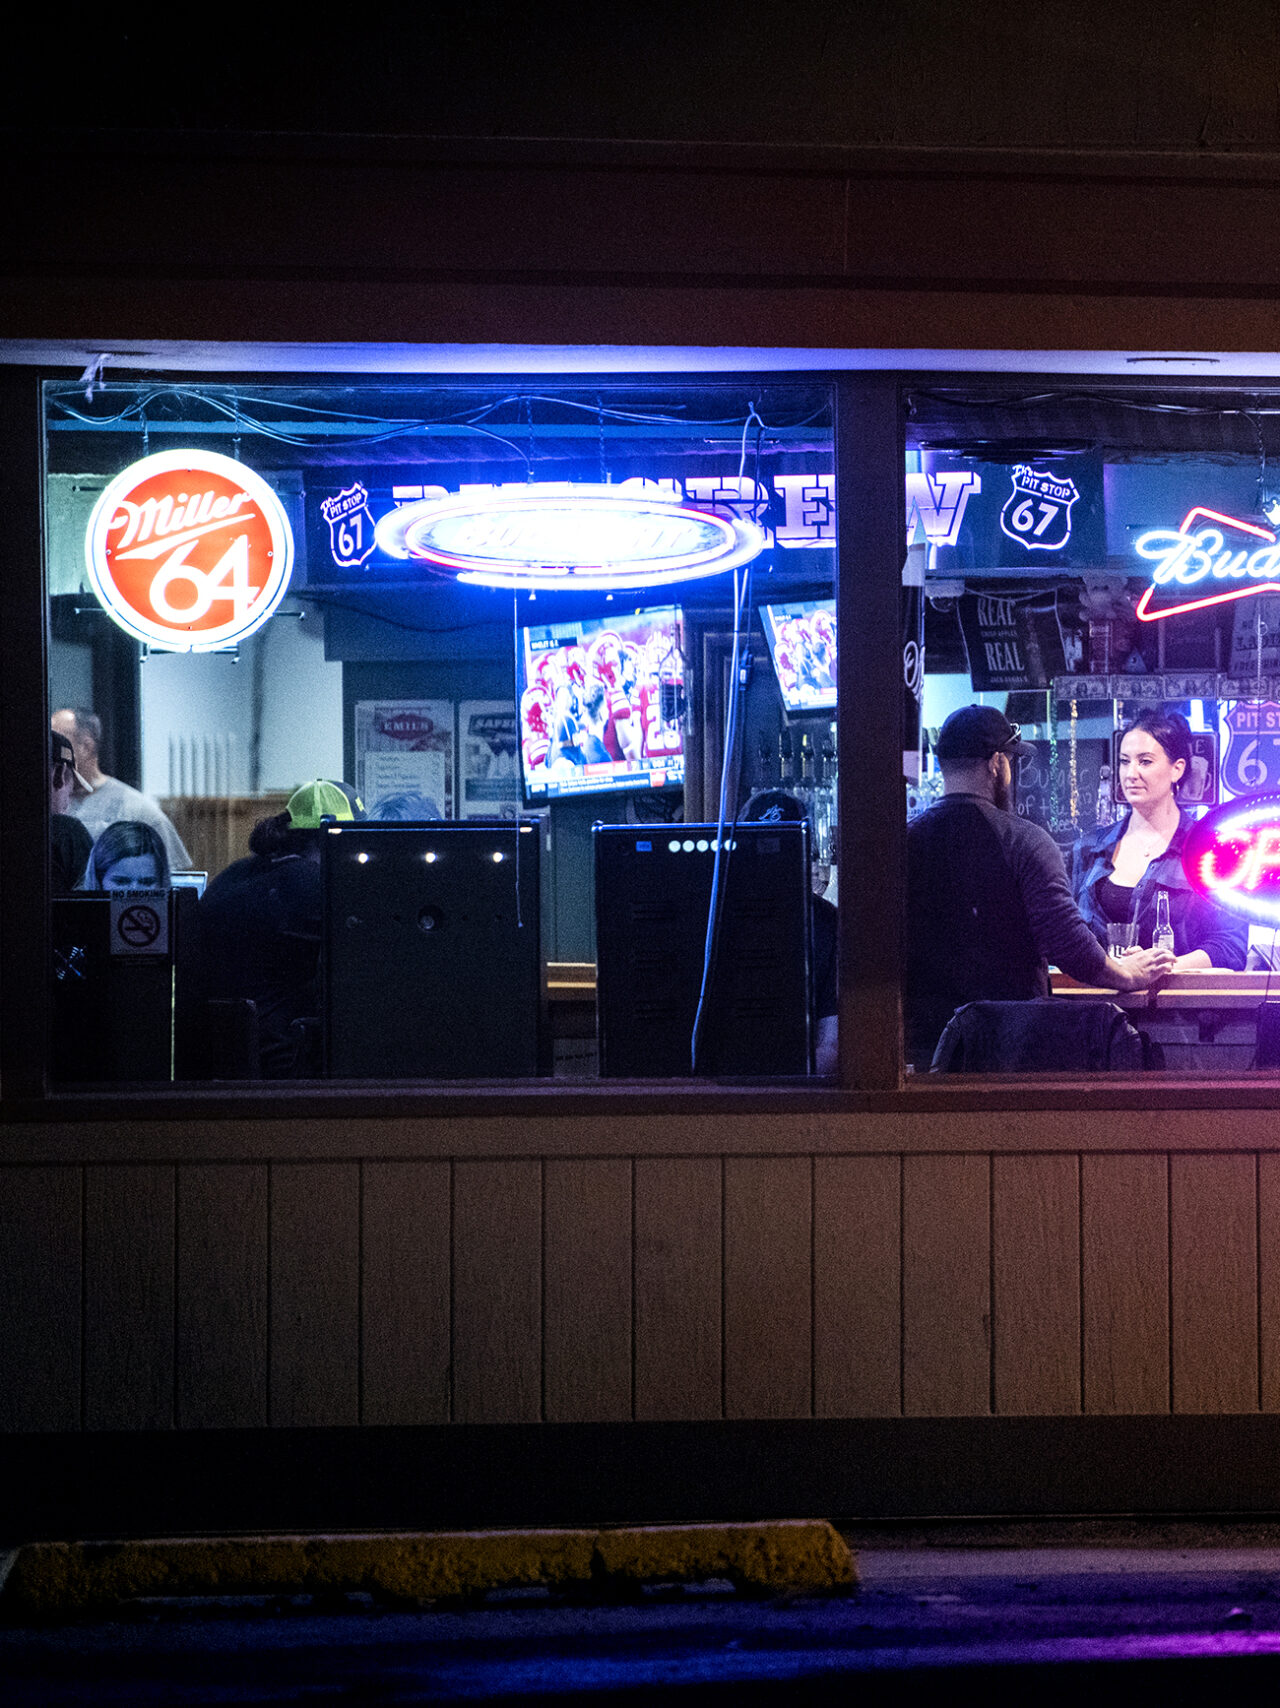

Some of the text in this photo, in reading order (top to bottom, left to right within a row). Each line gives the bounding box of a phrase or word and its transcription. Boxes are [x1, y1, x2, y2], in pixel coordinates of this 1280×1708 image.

[1021, 476, 1071, 498] PIT STOP
[107, 490, 255, 549] Miller
[330, 492, 362, 518] PIT STOP
[1011, 498, 1059, 536] 67
[338, 513, 362, 557] 67
[149, 534, 260, 626] 64
[977, 598, 1017, 627] REAL
[984, 642, 1024, 671] REAL
[1236, 711, 1260, 728] PIT
[112, 890, 166, 898] NO SMOKING
